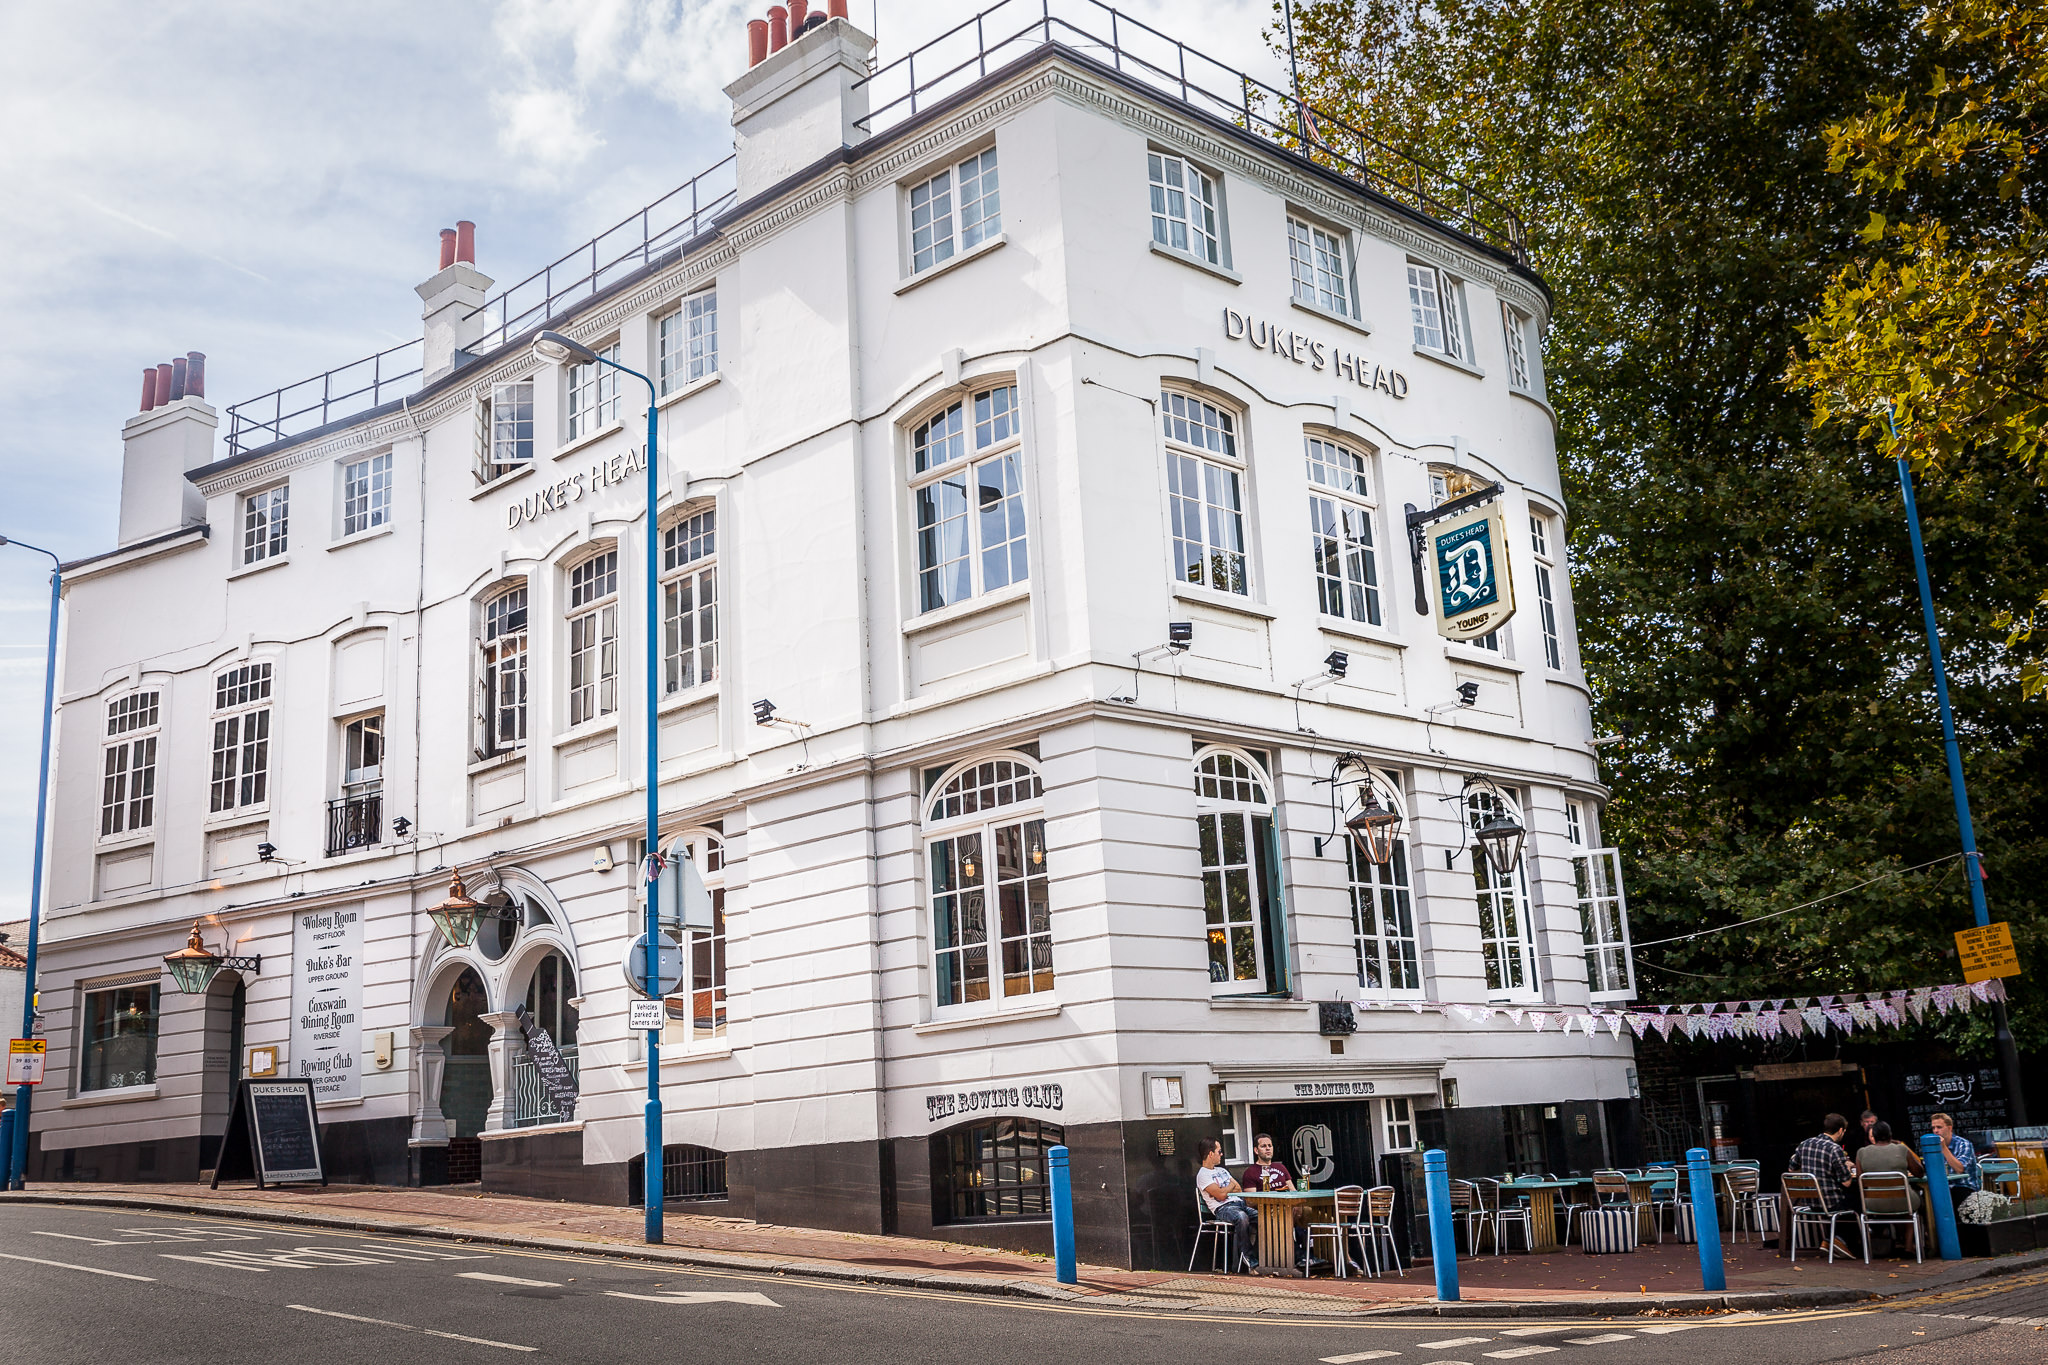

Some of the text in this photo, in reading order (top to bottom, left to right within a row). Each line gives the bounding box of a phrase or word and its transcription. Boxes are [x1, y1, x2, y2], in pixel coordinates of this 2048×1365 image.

[1223, 306, 1409, 399] DUKE'S HEAD
[507, 472, 585, 530] DUKE'S
[1465, 524, 1485, 537] HEAD
[302, 911, 357, 930] Wolsey Room
[313, 930, 346, 941] FIRST FLOOR
[1985, 933, 2000, 941] EVENT
[1960, 944, 2013, 959] PARKING RESTRICTIONS
[306, 953, 353, 972] Duke's Bar
[308, 971, 349, 983] UPPER GROUND
[308, 996, 347, 1013] Coxswain
[636, 1003, 658, 1011] Vehicles
[300, 1012, 355, 1030] Dining Room
[313, 1031, 341, 1040] RIVERSIDE
[300, 1052, 353, 1077] Rowing Club
[323, 1074, 347, 1084] GROUND
[252, 1086, 281, 1094] DUKE'S
[315, 1084, 341, 1093] TERRACE
[1294, 1082, 1375, 1096] THE ROWING CLUB
[926, 1083, 1064, 1122] THE ROWING CLUB
[1292, 1124, 1334, 1184] C
